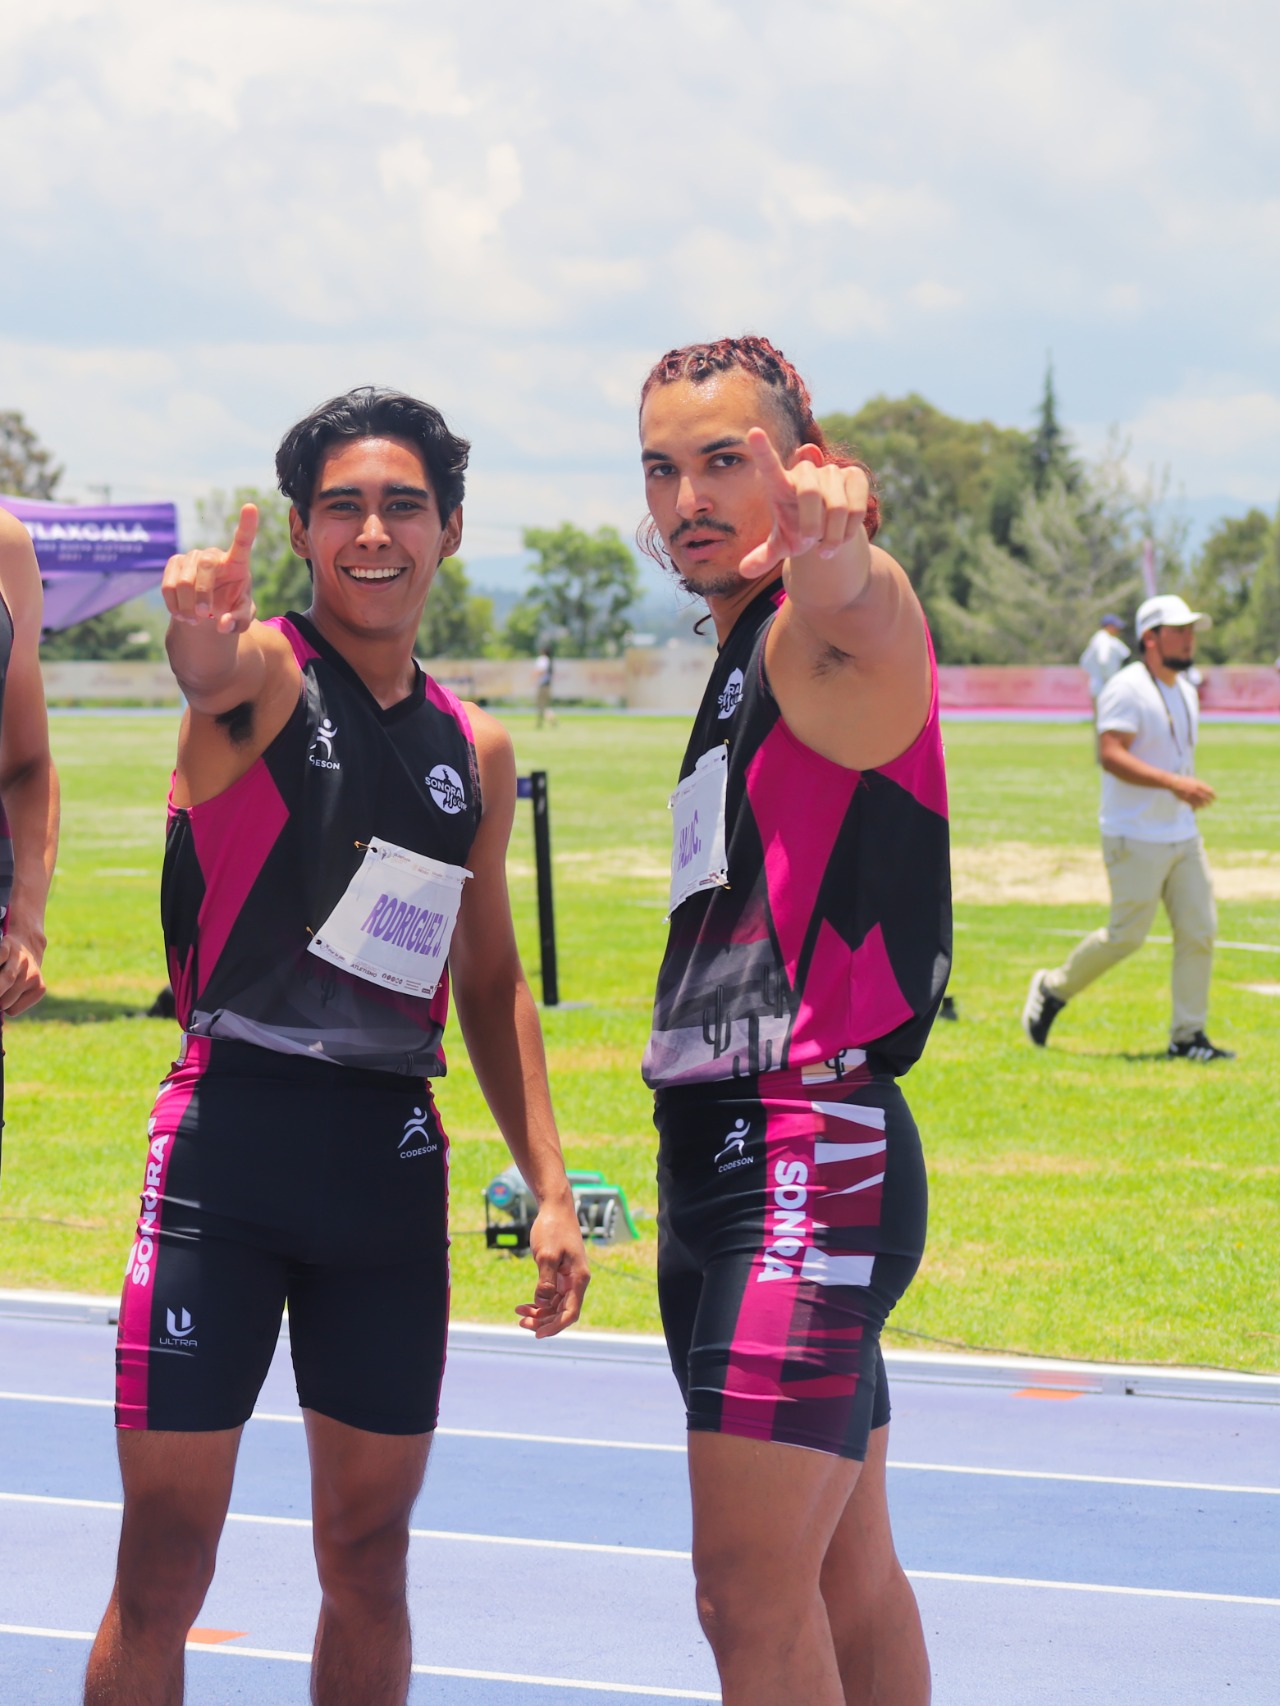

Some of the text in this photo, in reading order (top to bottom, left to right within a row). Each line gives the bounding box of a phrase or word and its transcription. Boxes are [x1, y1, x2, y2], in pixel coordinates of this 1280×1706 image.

[425, 776, 462, 799] SONORA
[360, 893, 444, 956] RODRIGUEZ
[400, 1144, 438, 1159] CODESON
[718, 1155, 754, 1173] CODESON
[131, 1134, 170, 1287] SONORA
[159, 1337, 198, 1347] ULTRA
